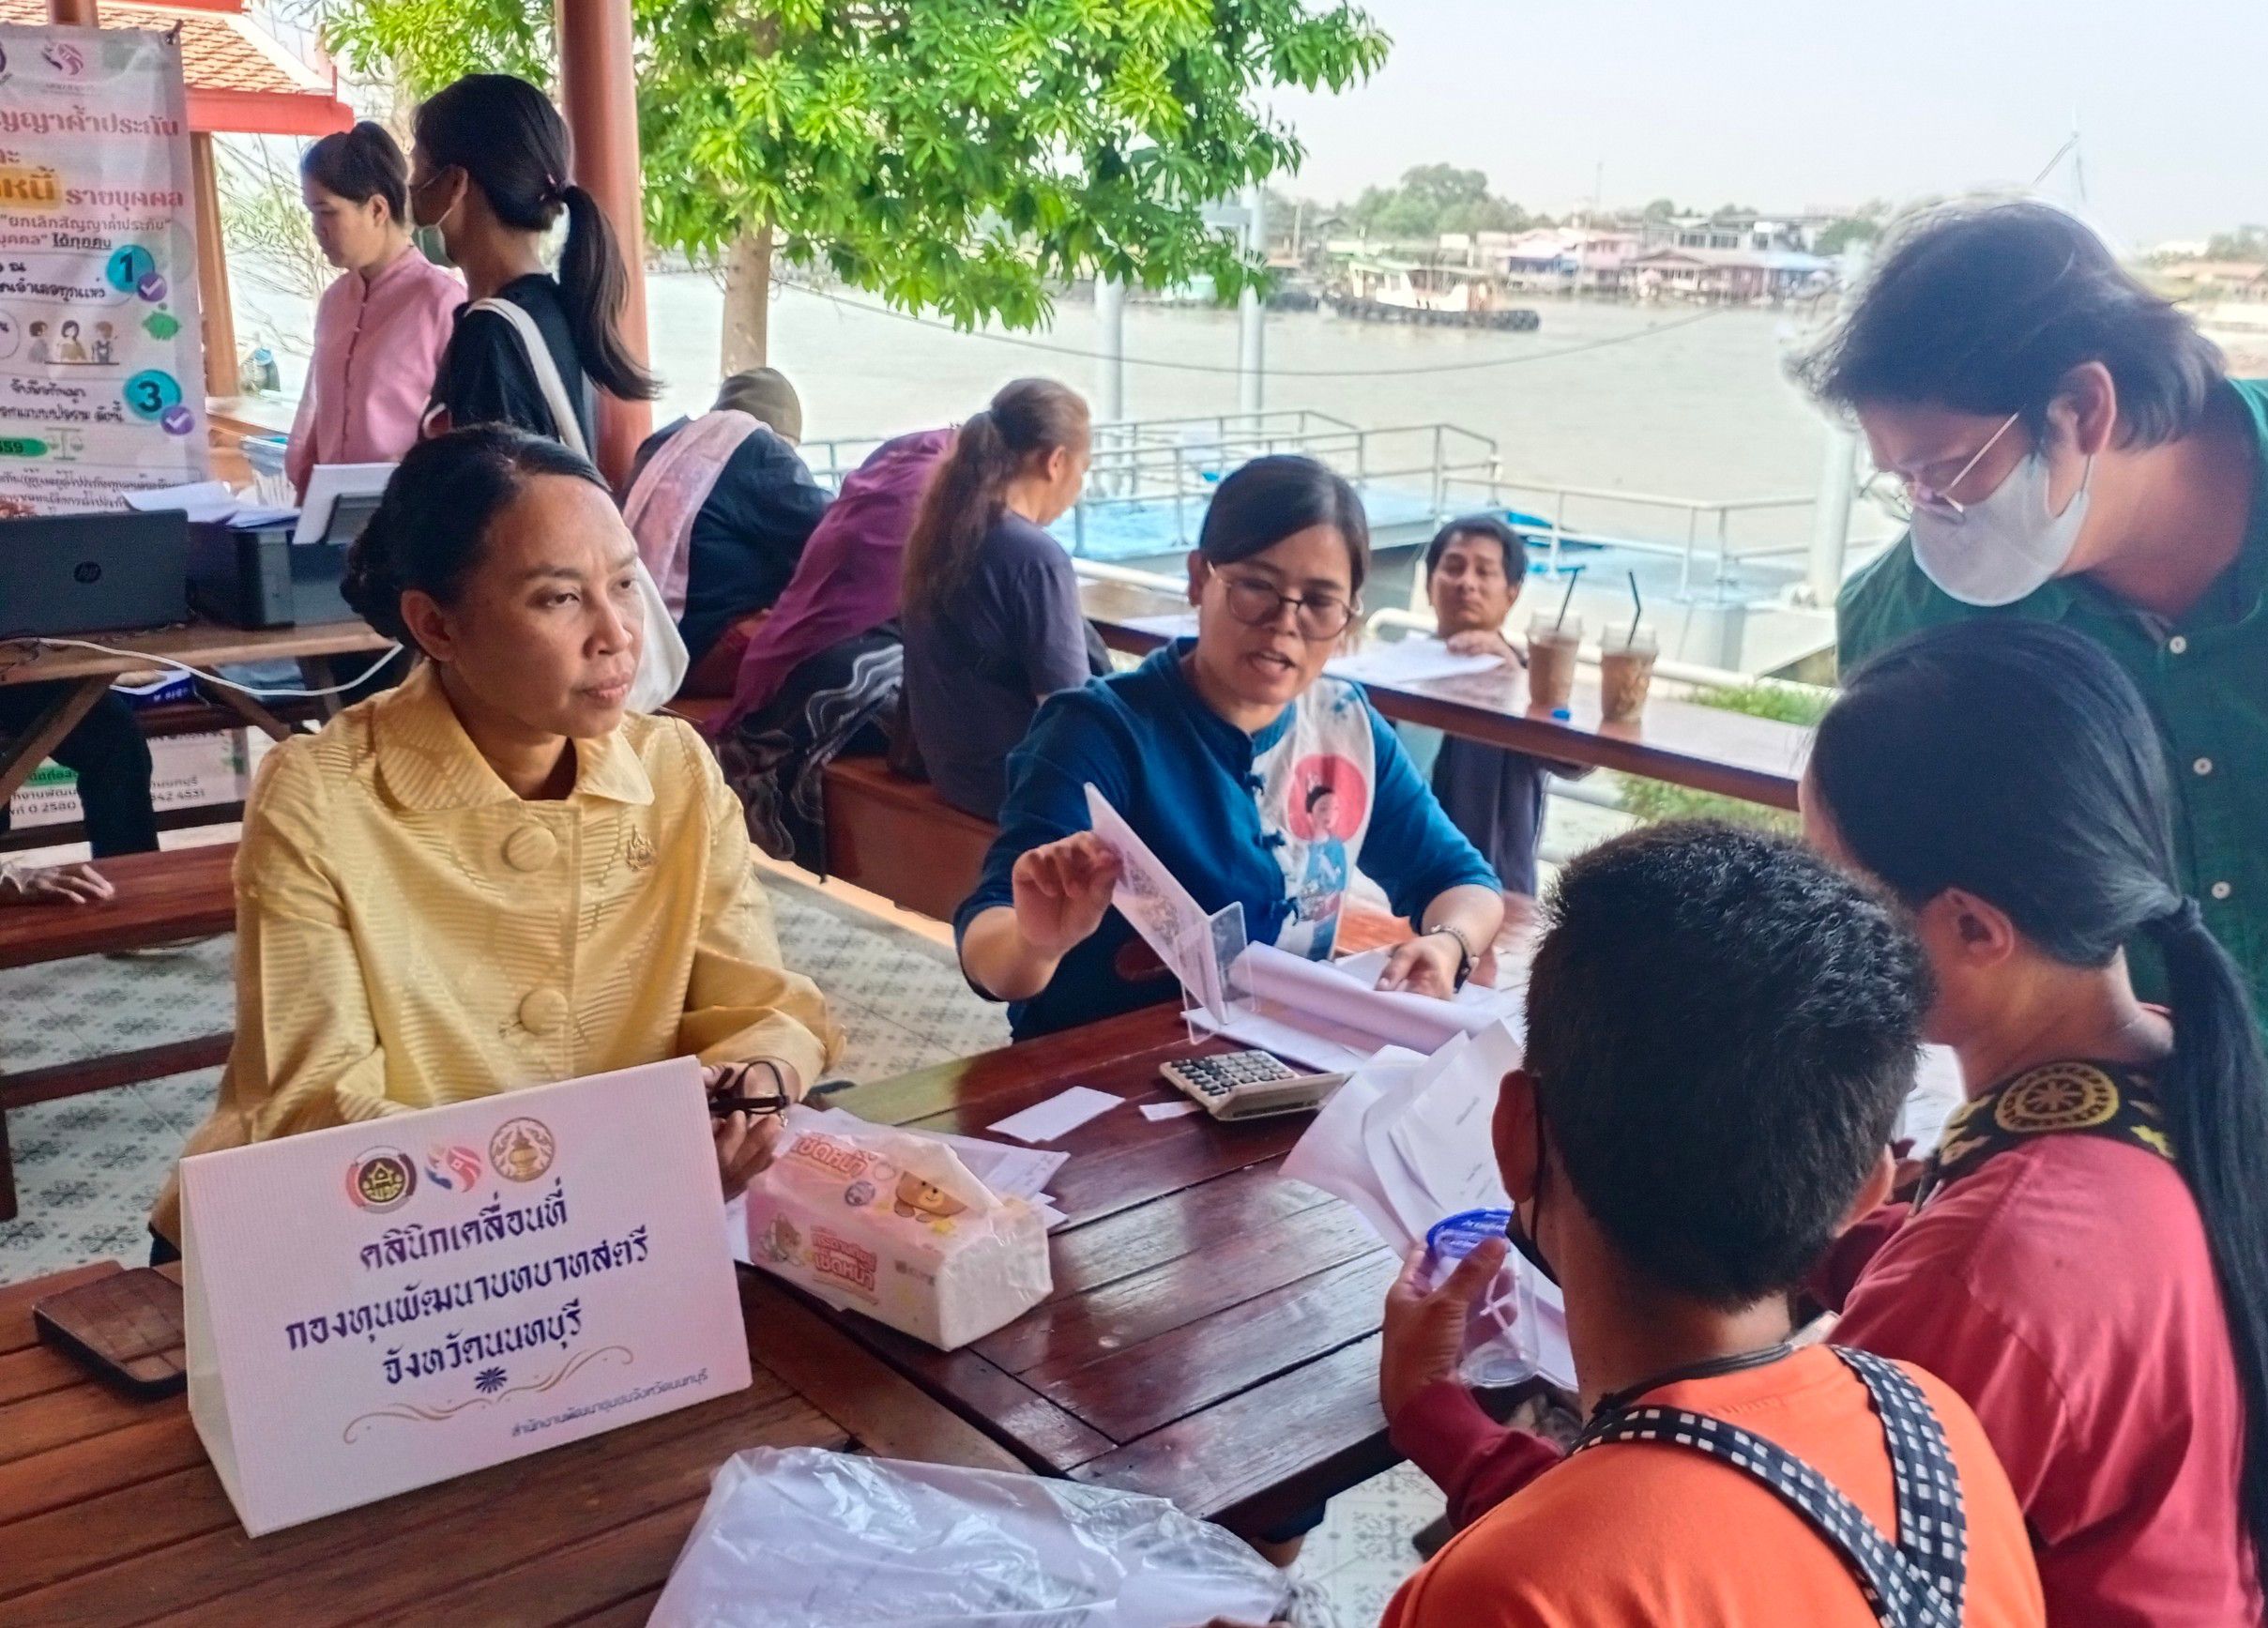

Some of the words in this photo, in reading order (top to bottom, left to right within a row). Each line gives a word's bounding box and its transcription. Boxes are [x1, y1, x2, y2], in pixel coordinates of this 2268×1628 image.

[66, 189, 184, 211] รายบุคคล
[119, 251, 134, 283] 1
[138, 380, 162, 413] 3
[359, 1177, 569, 1271] คลินิกเคลื่อนที่
[284, 1225, 650, 1351] กองทุนพัฒนาบทบาทสตรี
[382, 1299, 583, 1386] จังหวัดนนทบุรี
